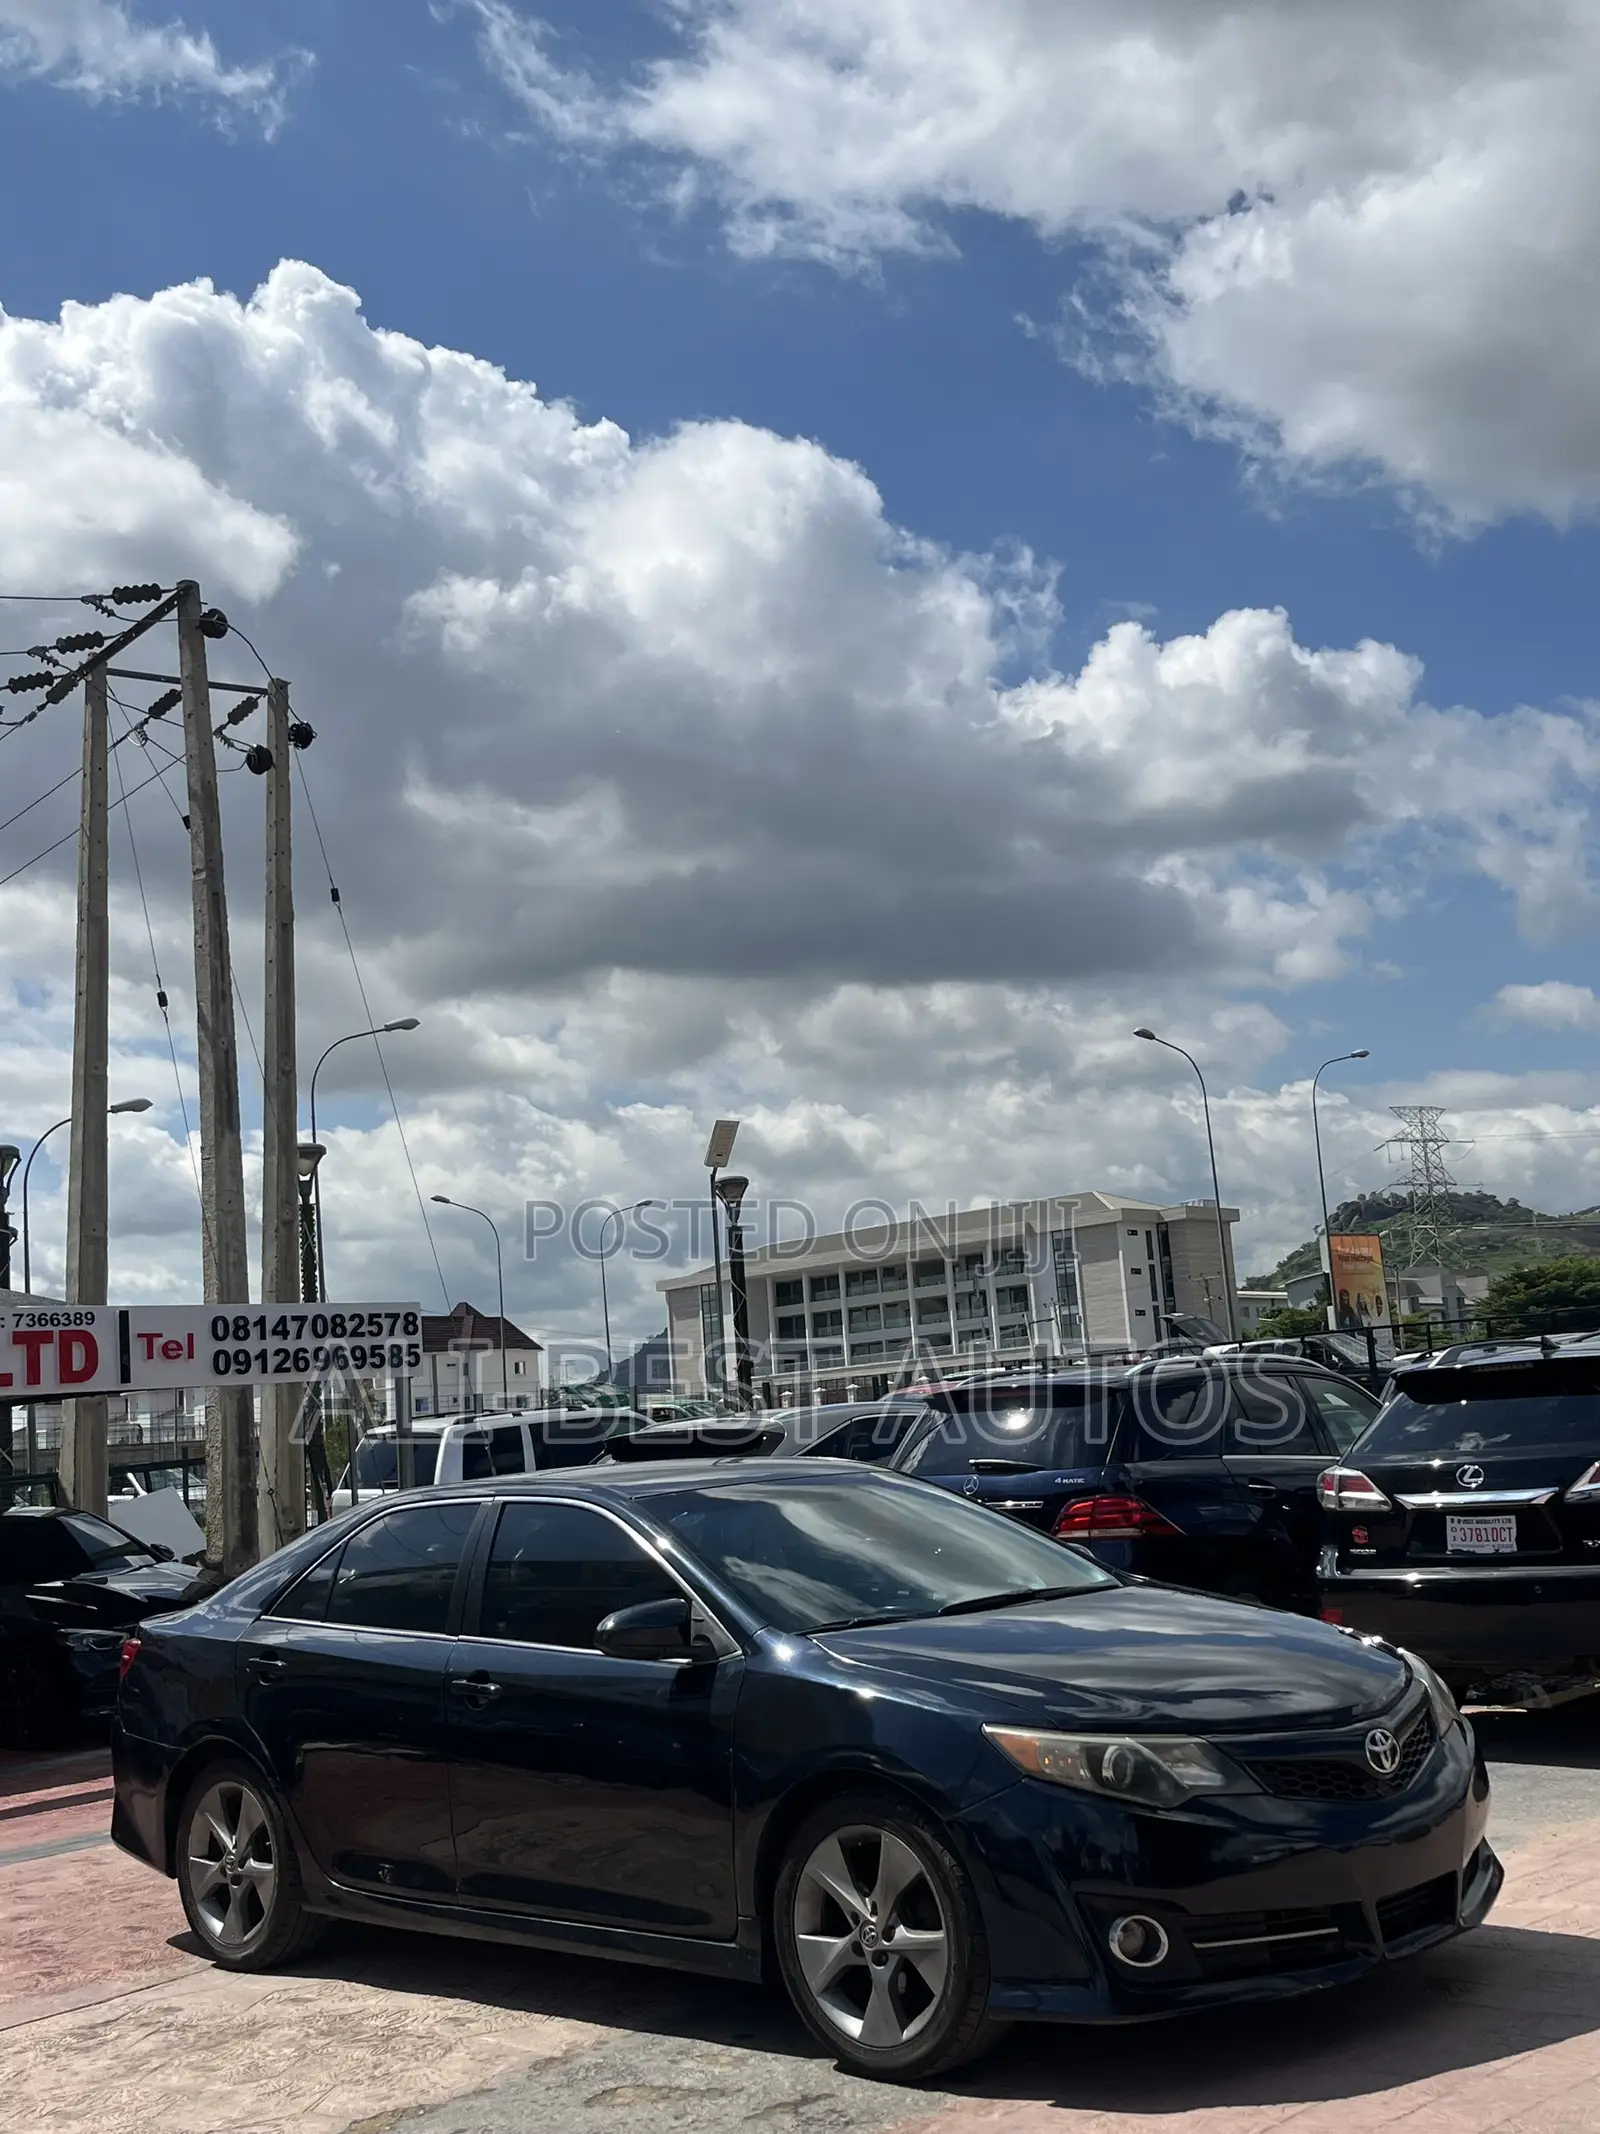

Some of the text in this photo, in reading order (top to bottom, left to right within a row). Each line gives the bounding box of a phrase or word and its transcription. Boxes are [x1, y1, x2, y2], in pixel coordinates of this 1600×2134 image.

[12, 1311, 96, 1328] 7366389
[211, 1311, 419, 1342] 08147082578
[137, 1332, 195, 1361] Tel
[213, 1343, 421, 1376] 09126969585
